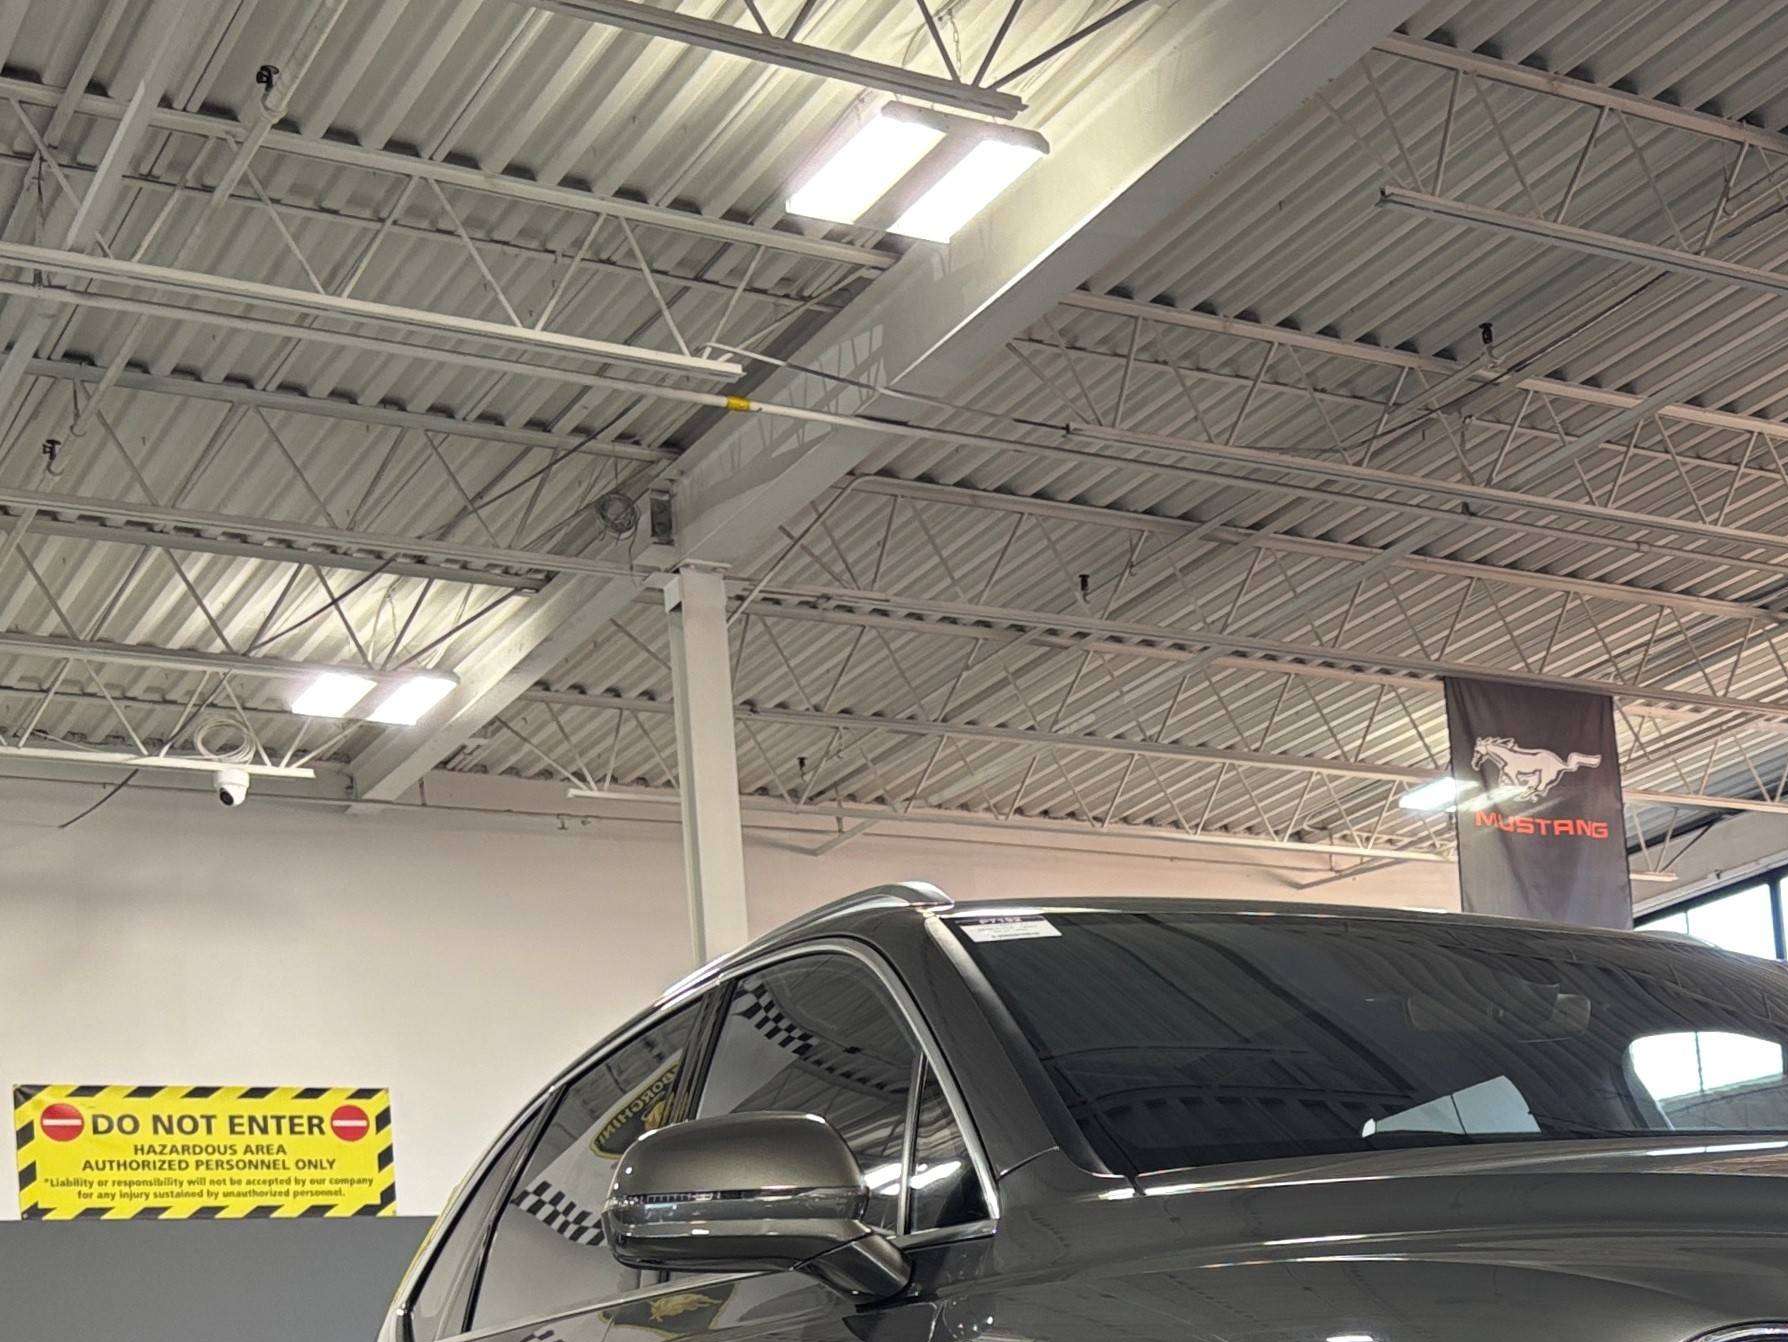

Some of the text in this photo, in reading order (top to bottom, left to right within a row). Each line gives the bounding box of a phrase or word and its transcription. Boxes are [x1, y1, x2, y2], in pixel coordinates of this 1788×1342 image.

[1475, 811, 1609, 839] MUSTANG
[91, 1113, 326, 1136] DO NOT ENTER
[134, 1144, 287, 1156] HAZARDOUS AREA
[82, 1158, 336, 1171] AUTHORIZED PERSONNEL ONLY
[98, 1179, 108, 1187] or
[112, 1177, 184, 1190] responsibility
[187, 1177, 206, 1187] will
[209, 1177, 227, 1186] not
[230, 1177, 243, 1186] be
[245, 1177, 291, 1189] accepted
[294, 1177, 306, 1188] by
[309, 1178, 326, 1186] our
[329, 1178, 374, 1188] company
[77, 1190, 93, 1199] for
[97, 1191, 116, 1200] any
[119, 1190, 150, 1200] injury
[153, 1190, 203, 1199] sustained
[207, 1188, 219, 1200] by
[223, 1188, 290, 1198] unauthorized
